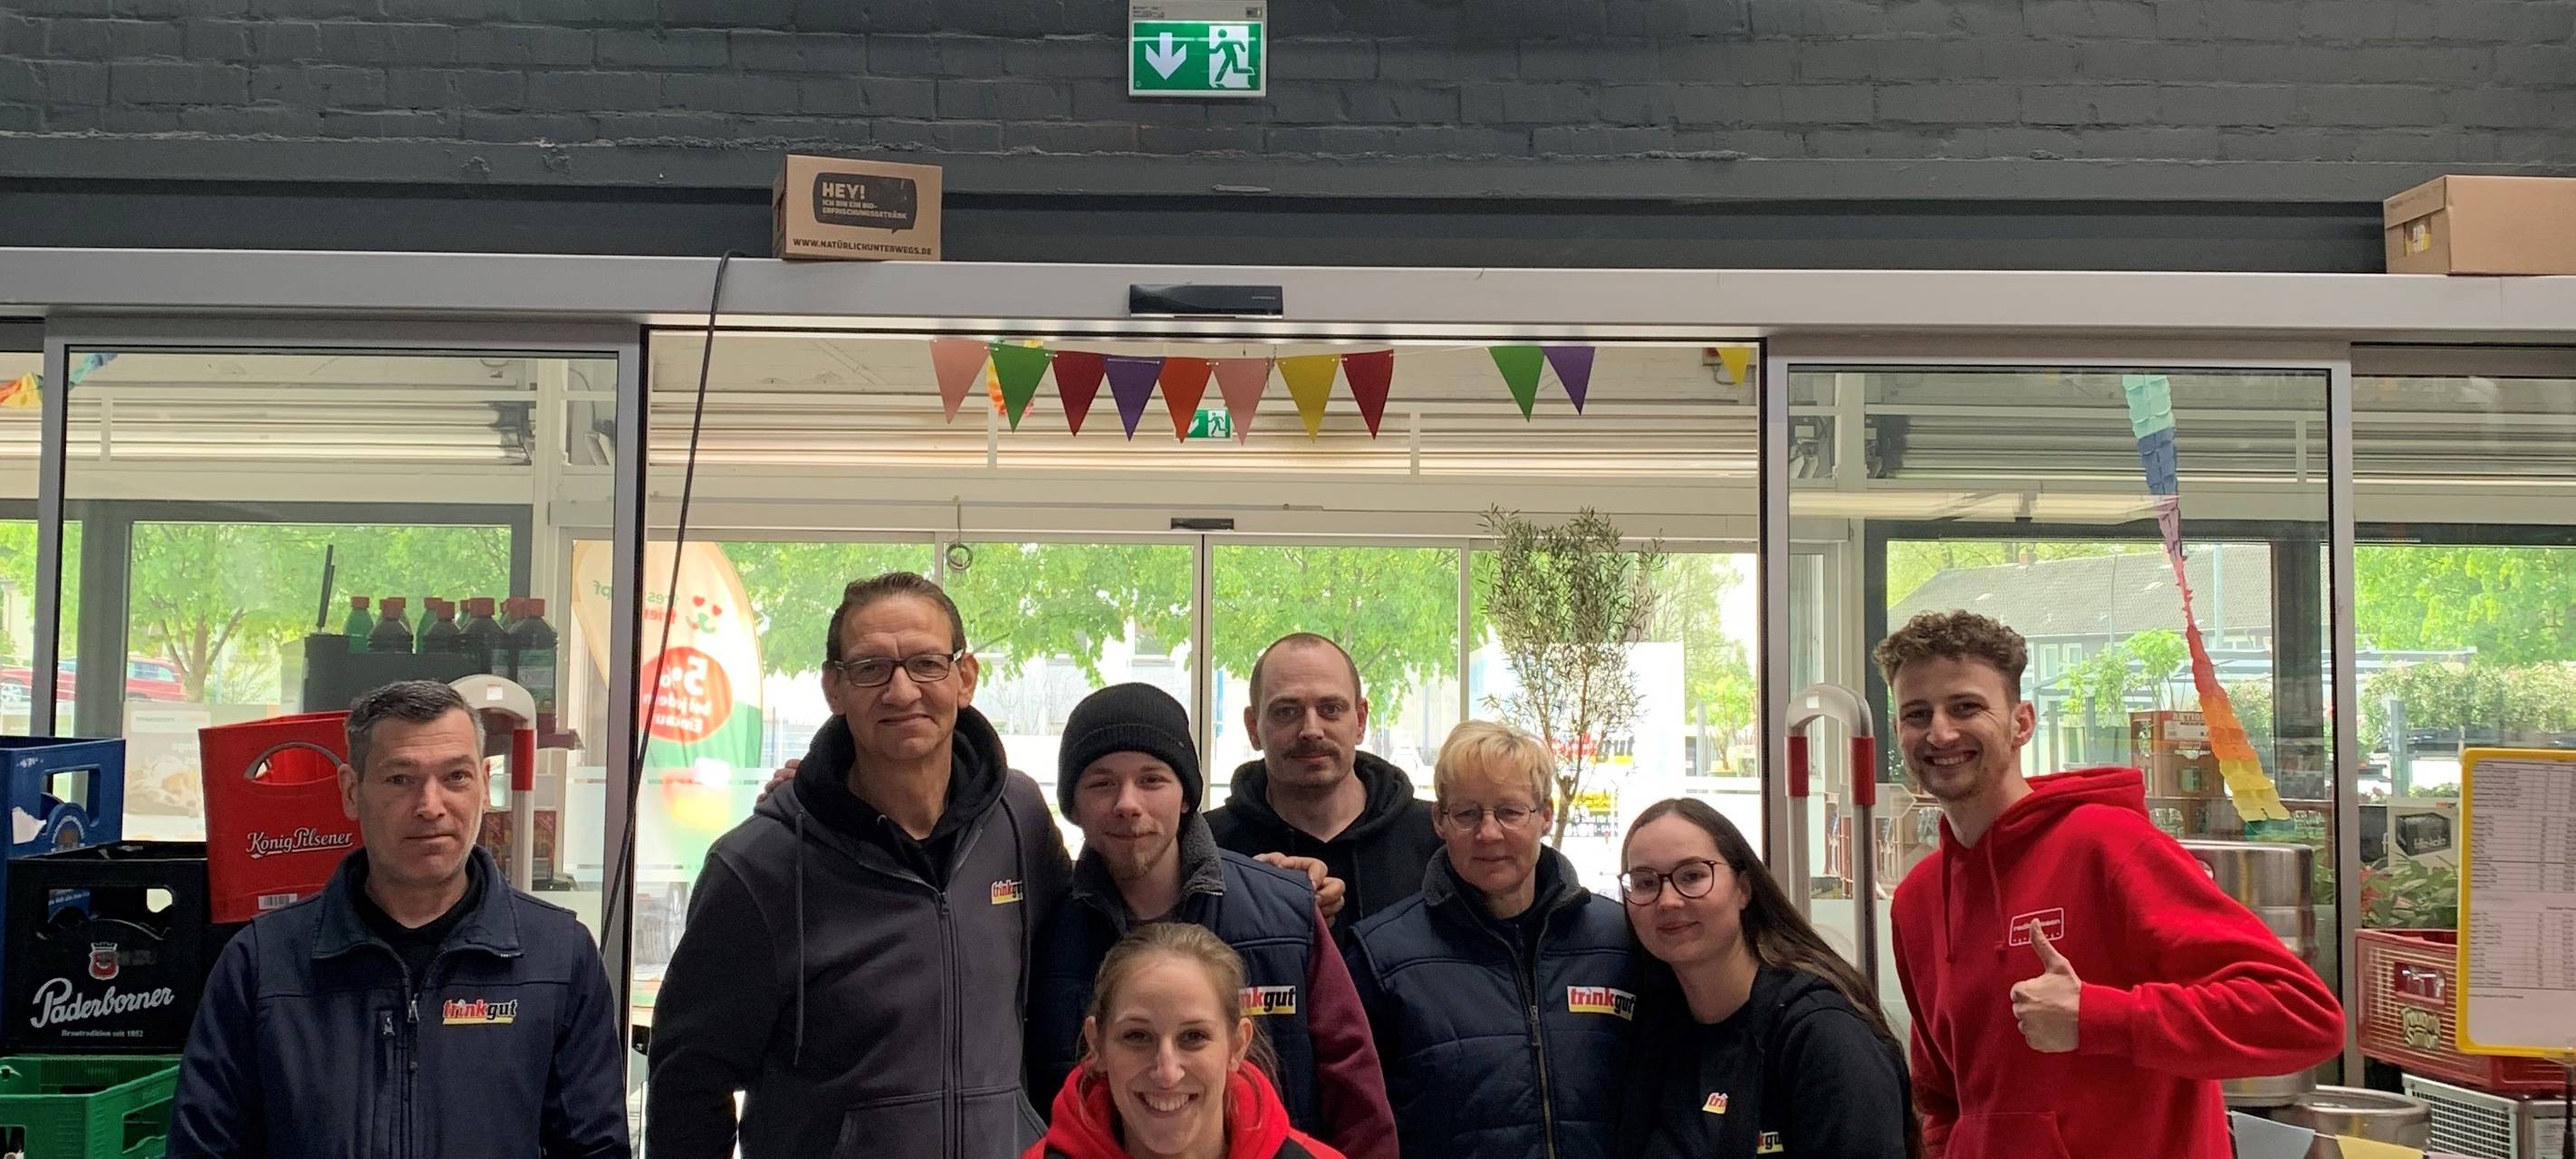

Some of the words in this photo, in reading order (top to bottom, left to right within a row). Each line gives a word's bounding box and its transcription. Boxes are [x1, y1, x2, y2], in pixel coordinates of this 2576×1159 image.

[822, 182, 866, 199] HEY!
[862, 202, 878, 210] BIO-
[793, 238, 933, 255] WWW.NATÜRLICHUNTERWEGS.DE
[246, 832, 293, 854] König
[293, 828, 352, 848] Pilsener
[30, 977, 175, 1029] Paderborner
[442, 999, 518, 1020] trinkgut
[1571, 986, 1635, 1014] trinkgut
